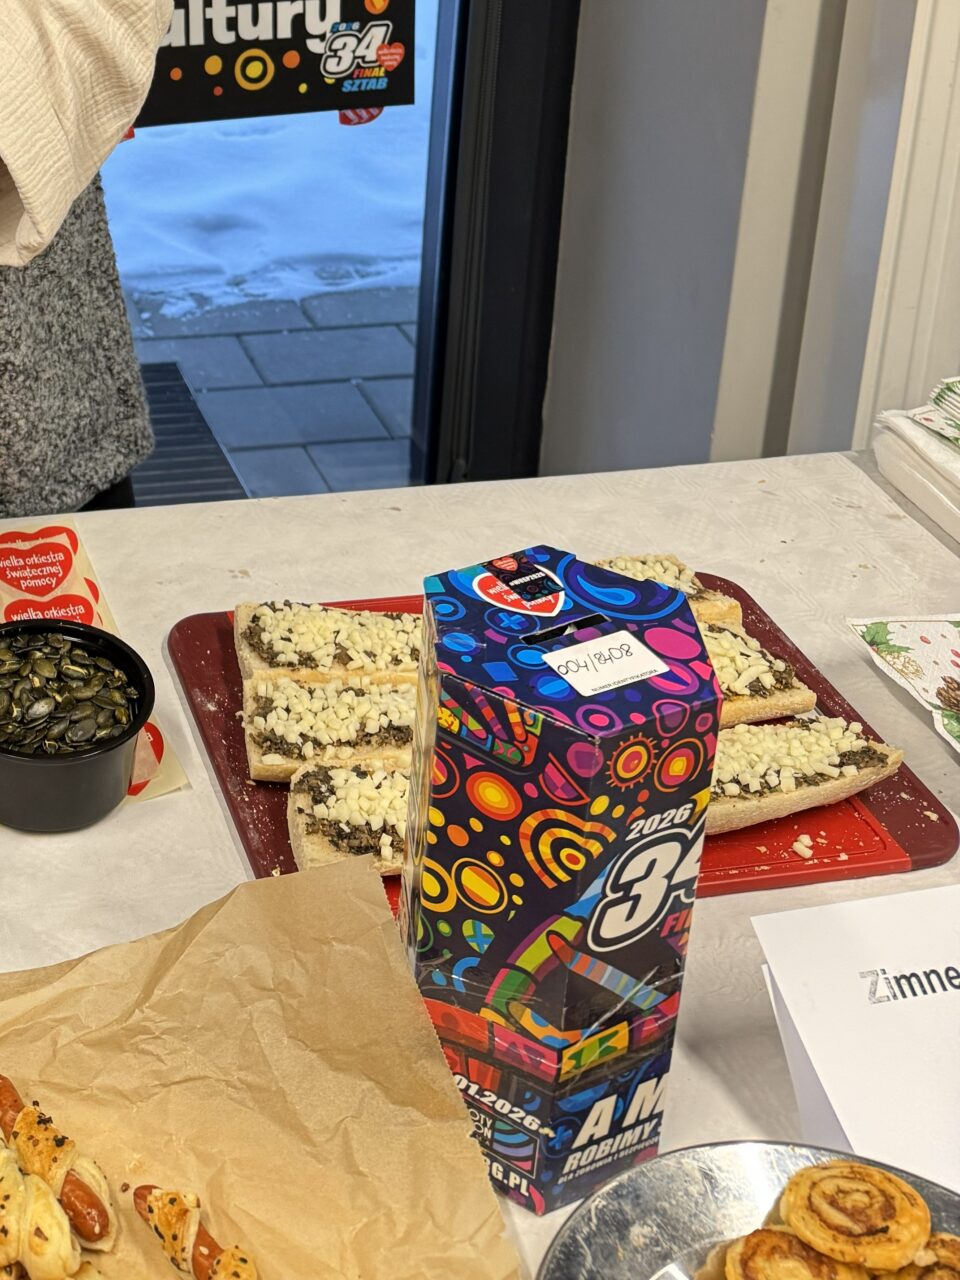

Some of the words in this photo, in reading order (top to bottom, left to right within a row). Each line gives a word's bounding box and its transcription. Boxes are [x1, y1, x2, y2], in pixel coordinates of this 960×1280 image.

[330, 21, 360, 33] 2026
[320, 20, 393, 78] 34
[342, 77, 389, 93] SZTAB
[25, 551, 65, 566] orkiestra
[5, 563, 63, 580] świątecznej
[20, 577, 57, 590] pomocy
[11, 607, 43, 622] wielka
[43, 604, 86, 618] orkiestra
[557, 643, 634, 675] 004/8408
[625, 803, 693, 841] 2026
[452, 1073, 541, 1132] 01.2026
[468, 1108, 493, 1129] OTY
[570, 1094, 617, 1150] A
[562, 1118, 659, 1175] ROBIMY
